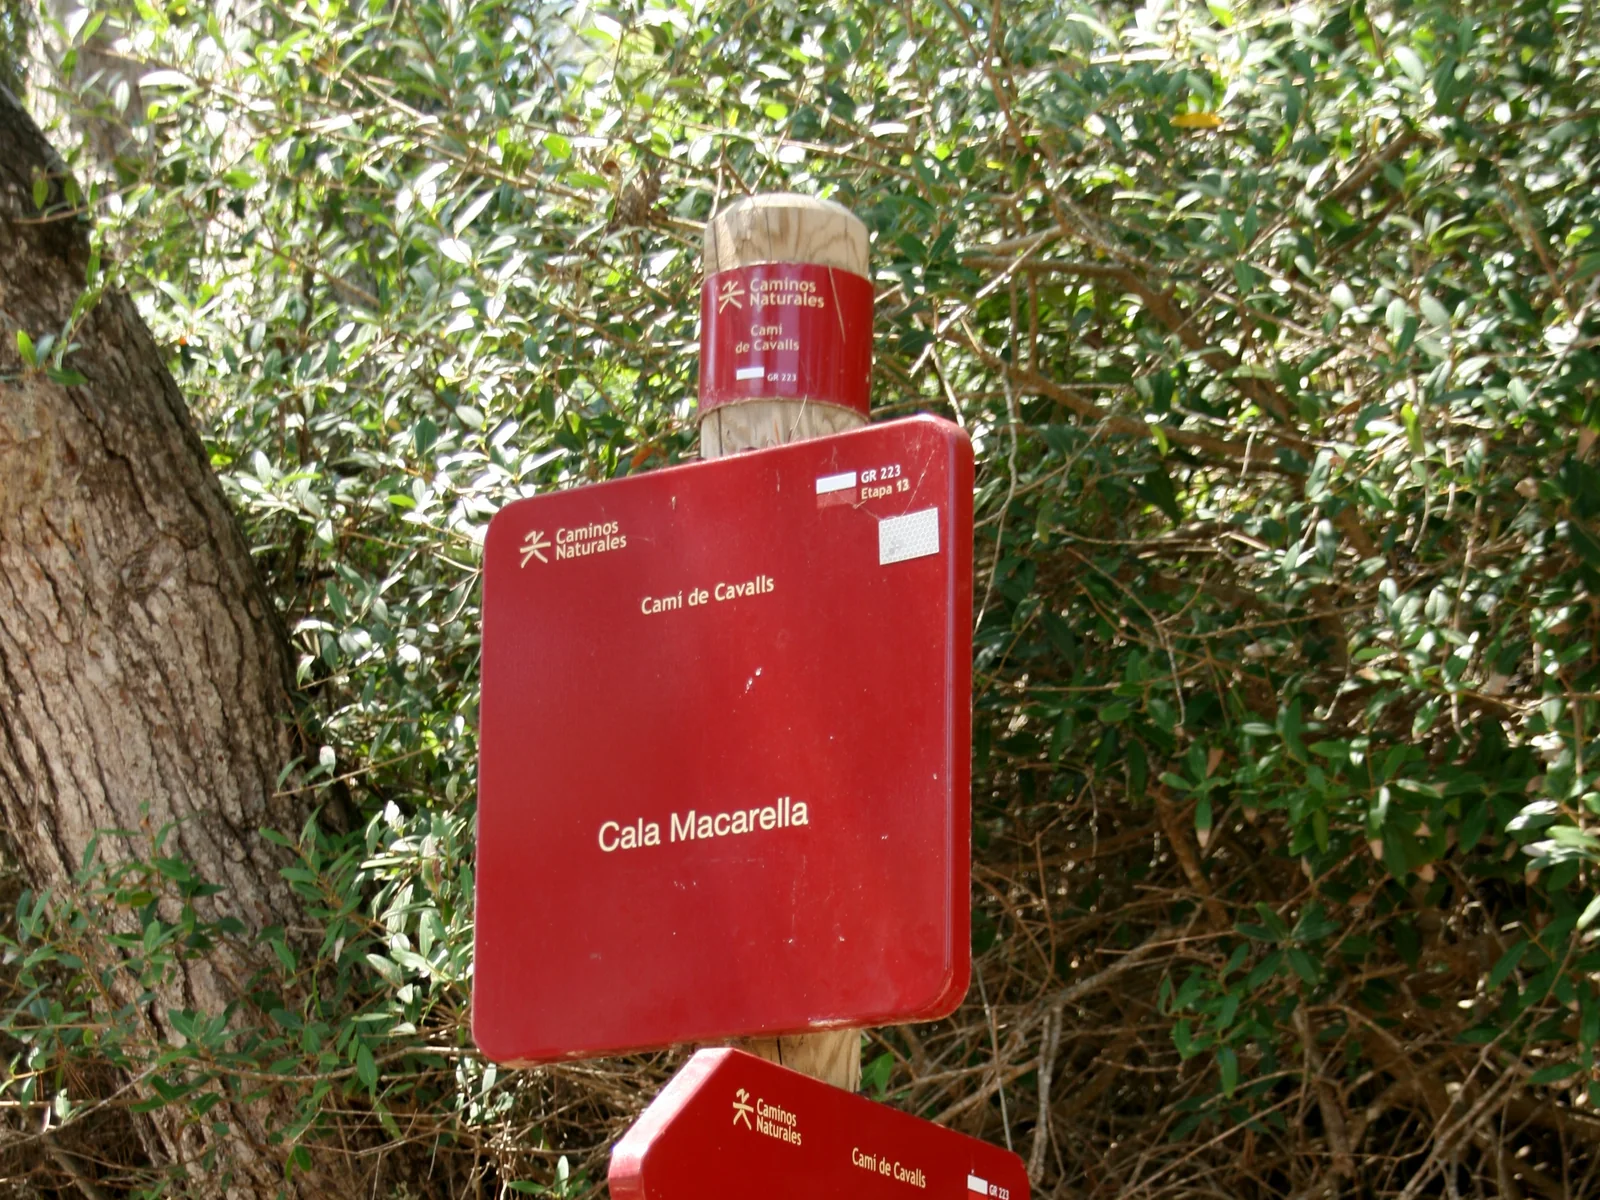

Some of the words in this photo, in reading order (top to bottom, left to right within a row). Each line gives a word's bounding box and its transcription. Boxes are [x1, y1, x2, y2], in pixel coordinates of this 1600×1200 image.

[750, 277, 816, 293] Caminos
[750, 293, 825, 309] Naturales
[750, 323, 783, 337] Camí
[735, 342, 750, 354] de
[754, 339, 799, 351] Cavalls
[767, 373, 778, 382] GR
[781, 373, 797, 382] 223
[861, 470, 877, 484] GR
[880, 464, 901, 479] 223
[861, 485, 893, 500] Etapa
[896, 479, 910, 493] 13
[556, 521, 619, 545] Caminos
[556, 534, 627, 560] Naturales
[641, 590, 683, 615] Camí
[688, 588, 709, 606] de
[714, 575, 775, 602] Cavalls
[598, 817, 661, 852] Cala
[670, 796, 809, 842] Macarella
[756, 1098, 797, 1127] Caminos
[756, 1116, 802, 1146] Naturales
[852, 1147, 877, 1173] Camí
[879, 1156, 891, 1177] de
[893, 1161, 926, 1188] Cavalls
[989, 1184, 998, 1197] GR
[998, 1186, 1010, 1200] 223
